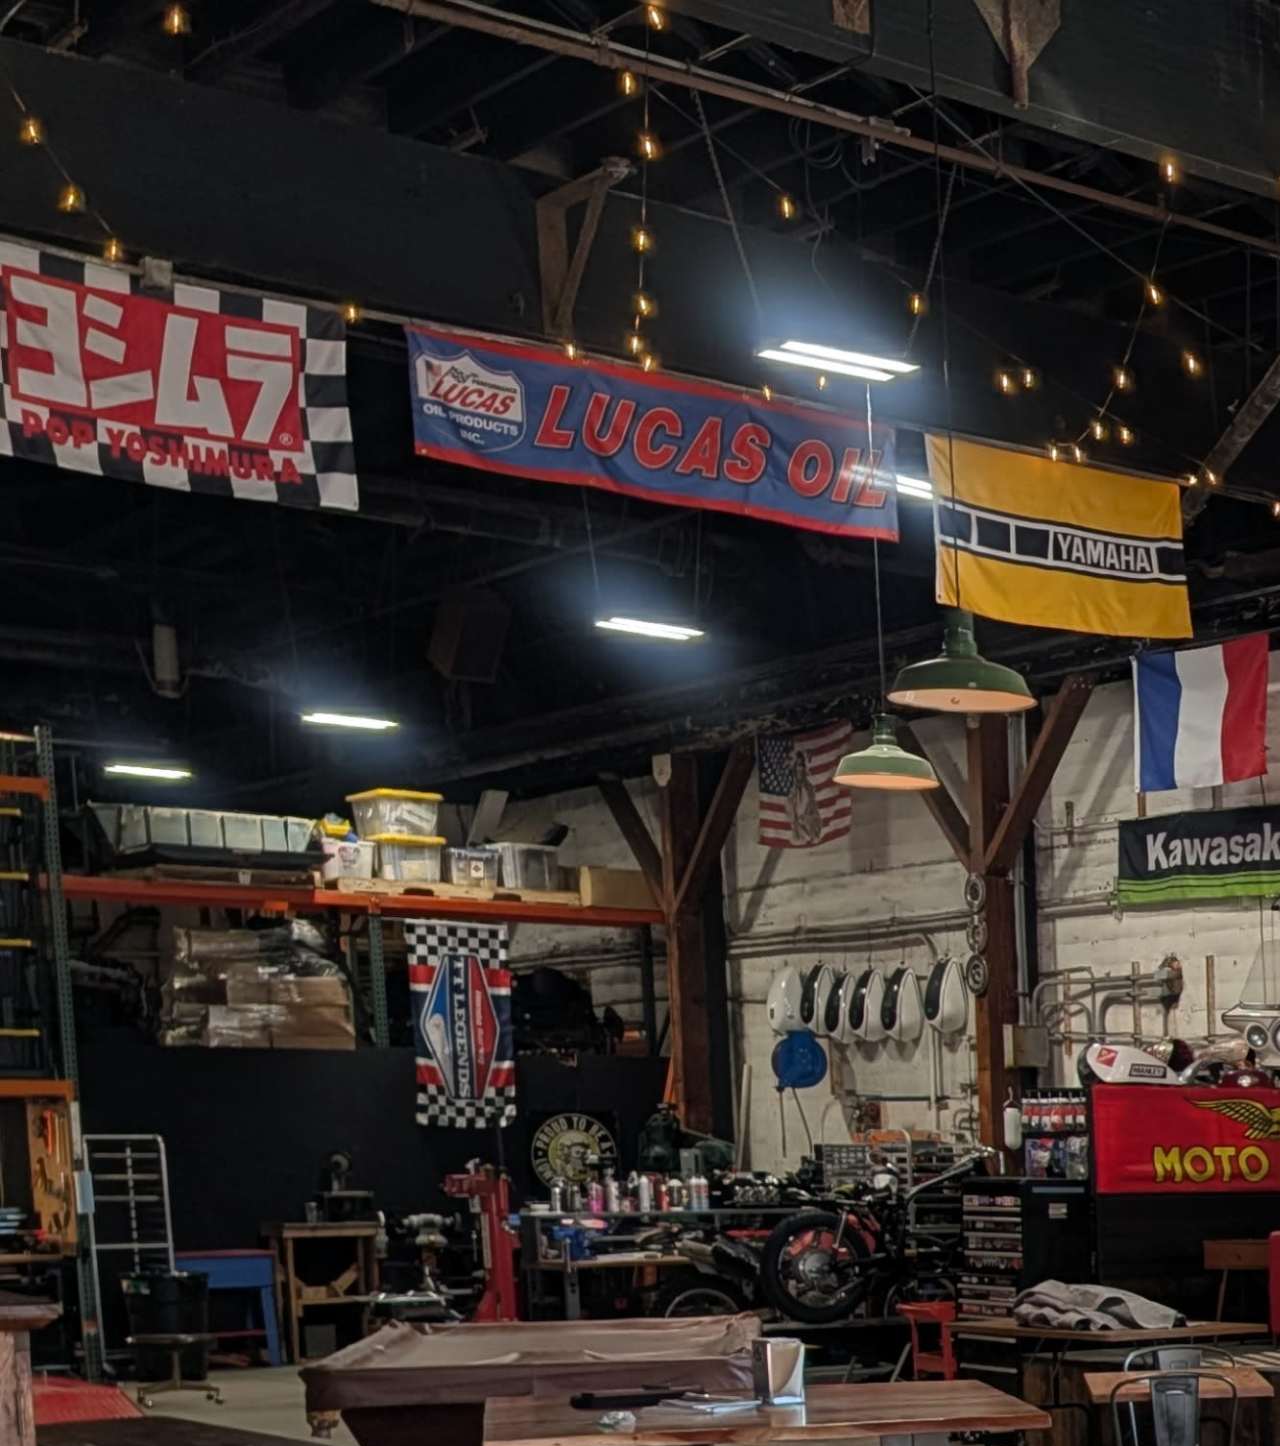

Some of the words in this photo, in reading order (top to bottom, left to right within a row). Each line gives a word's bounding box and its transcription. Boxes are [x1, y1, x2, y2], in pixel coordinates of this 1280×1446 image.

[430, 380, 516, 416] LUCAS
[423, 403, 447, 418] OIL
[448, 411, 519, 436] PRODUCTS
[460, 428, 485, 446] INC.
[21, 408, 95, 450] POP
[105, 425, 304, 484] YOSHIMURA
[534, 384, 772, 484] LUCAS
[787, 438, 888, 509] OIL
[1055, 531, 1153, 574] YAMAHA
[453, 993, 472, 1098] LEGENDS
[1152, 1145, 1270, 1184] MOTO
